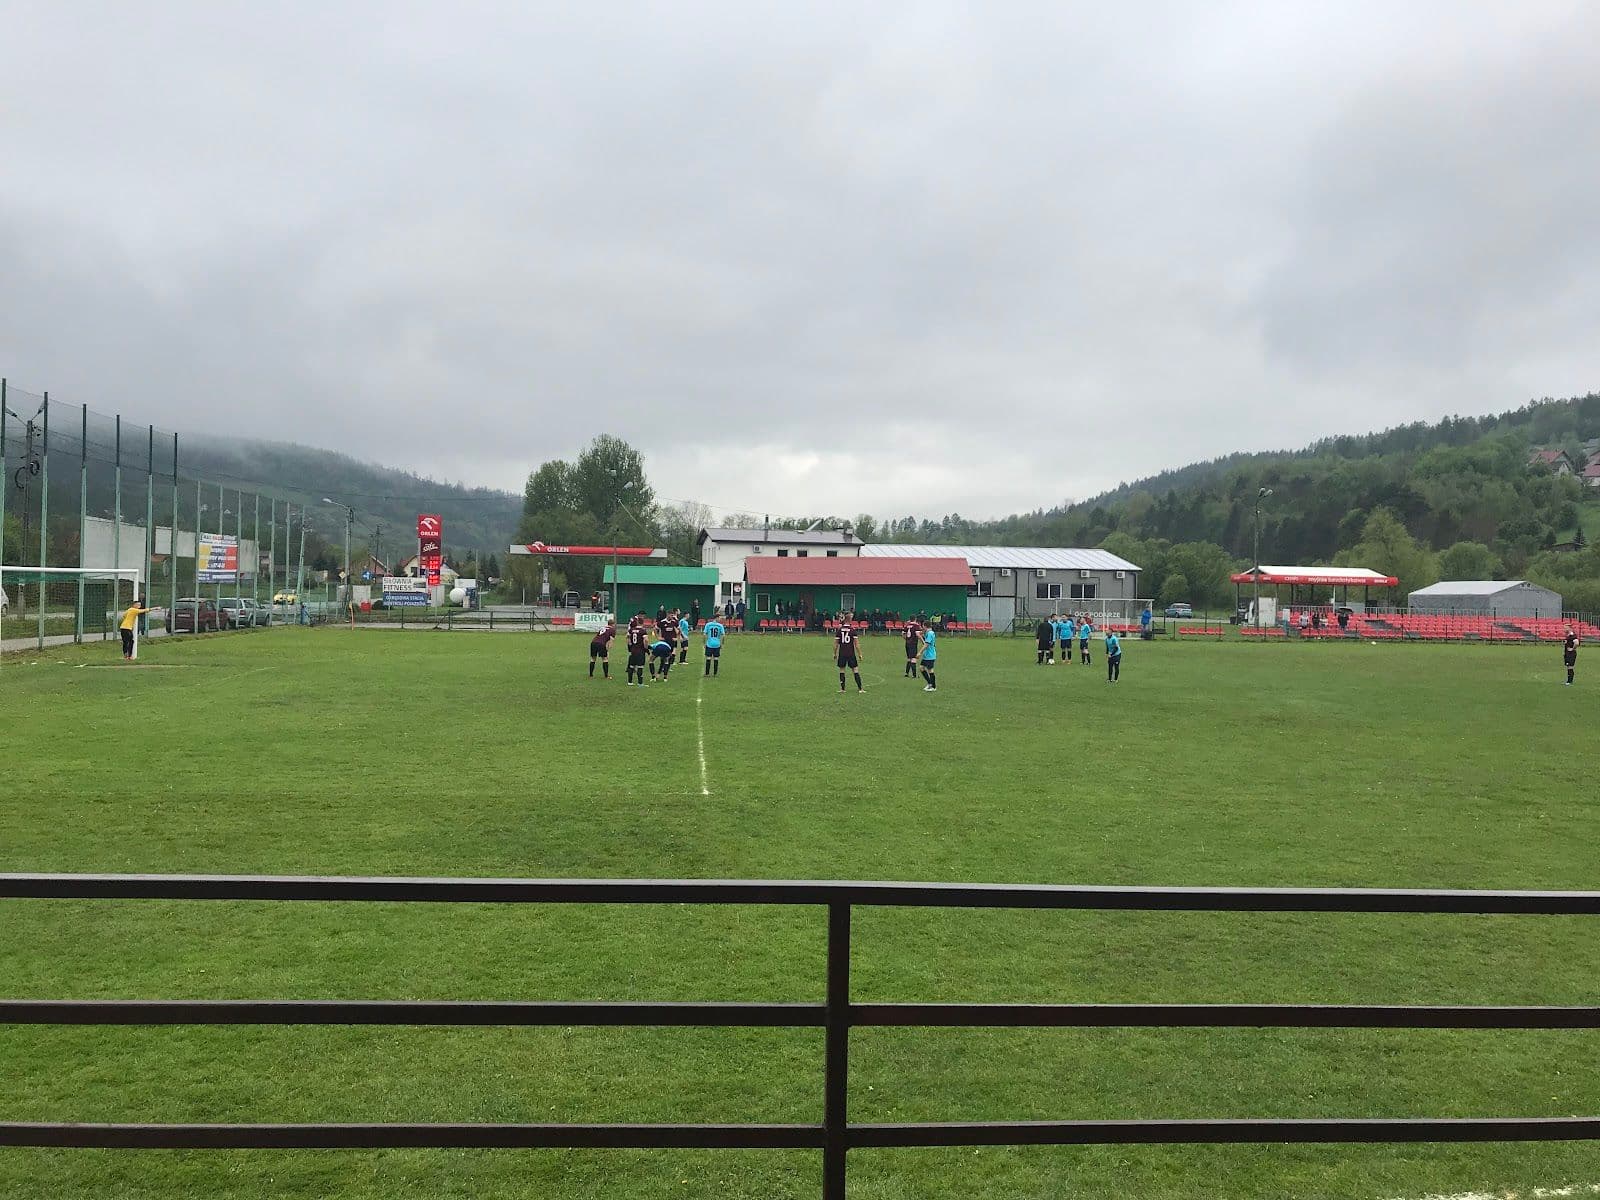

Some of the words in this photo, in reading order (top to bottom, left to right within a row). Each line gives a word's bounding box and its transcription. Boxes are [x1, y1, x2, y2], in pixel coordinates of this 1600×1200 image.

[710, 627, 719, 638] 16
[841, 631, 851, 643] 16
[632, 633, 638, 644] 8
